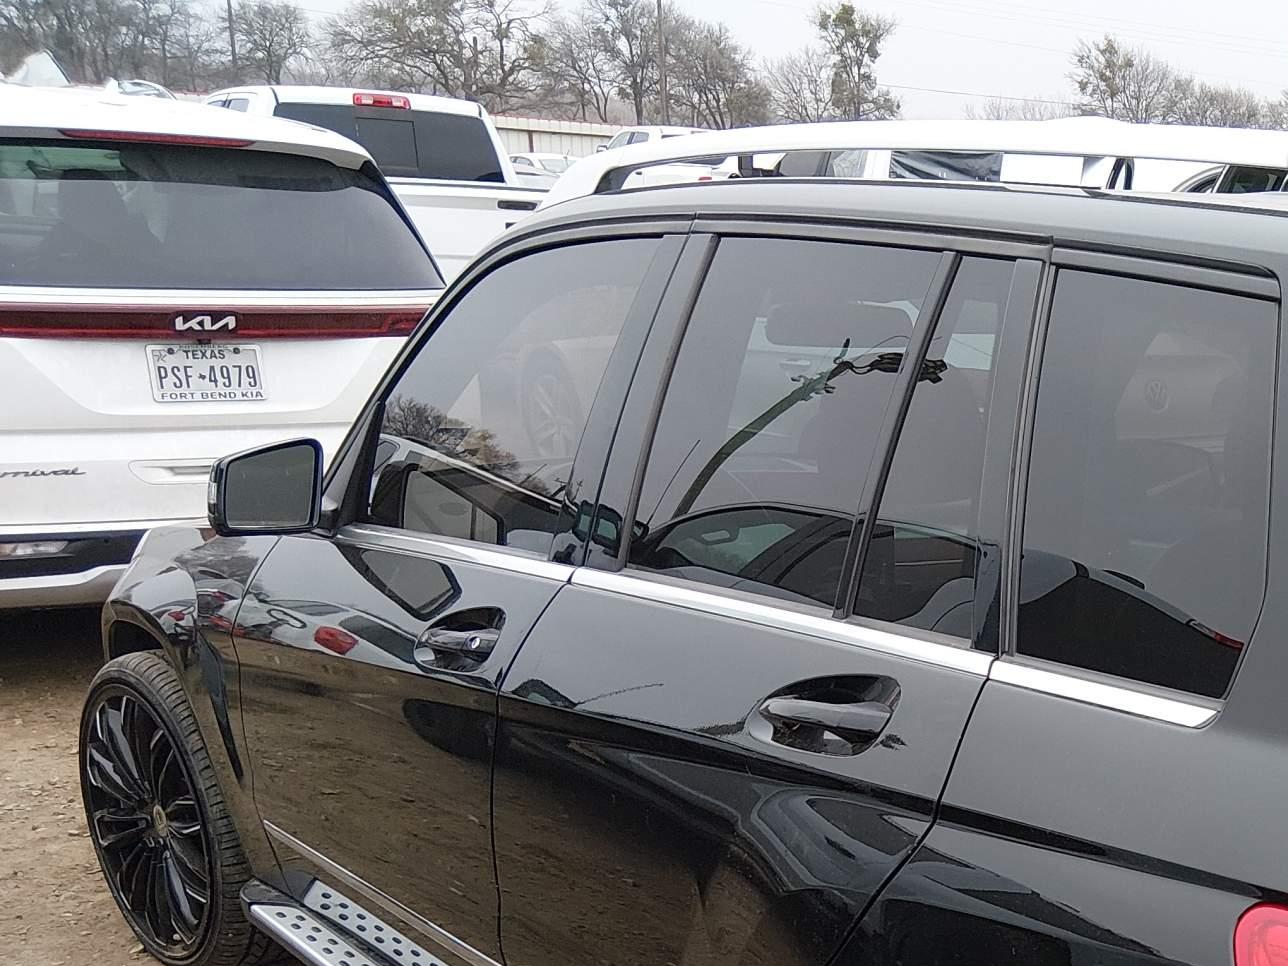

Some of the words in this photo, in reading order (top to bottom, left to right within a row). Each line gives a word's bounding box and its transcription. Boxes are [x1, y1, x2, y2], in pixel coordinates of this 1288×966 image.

[183, 349, 226, 360] TEXAS
[157, 365, 193, 389] PSF
[208, 364, 258, 389] 4979
[161, 392, 196, 400] FORT
[201, 391, 237, 400] BEND
[241, 391, 264, 399] KIA
